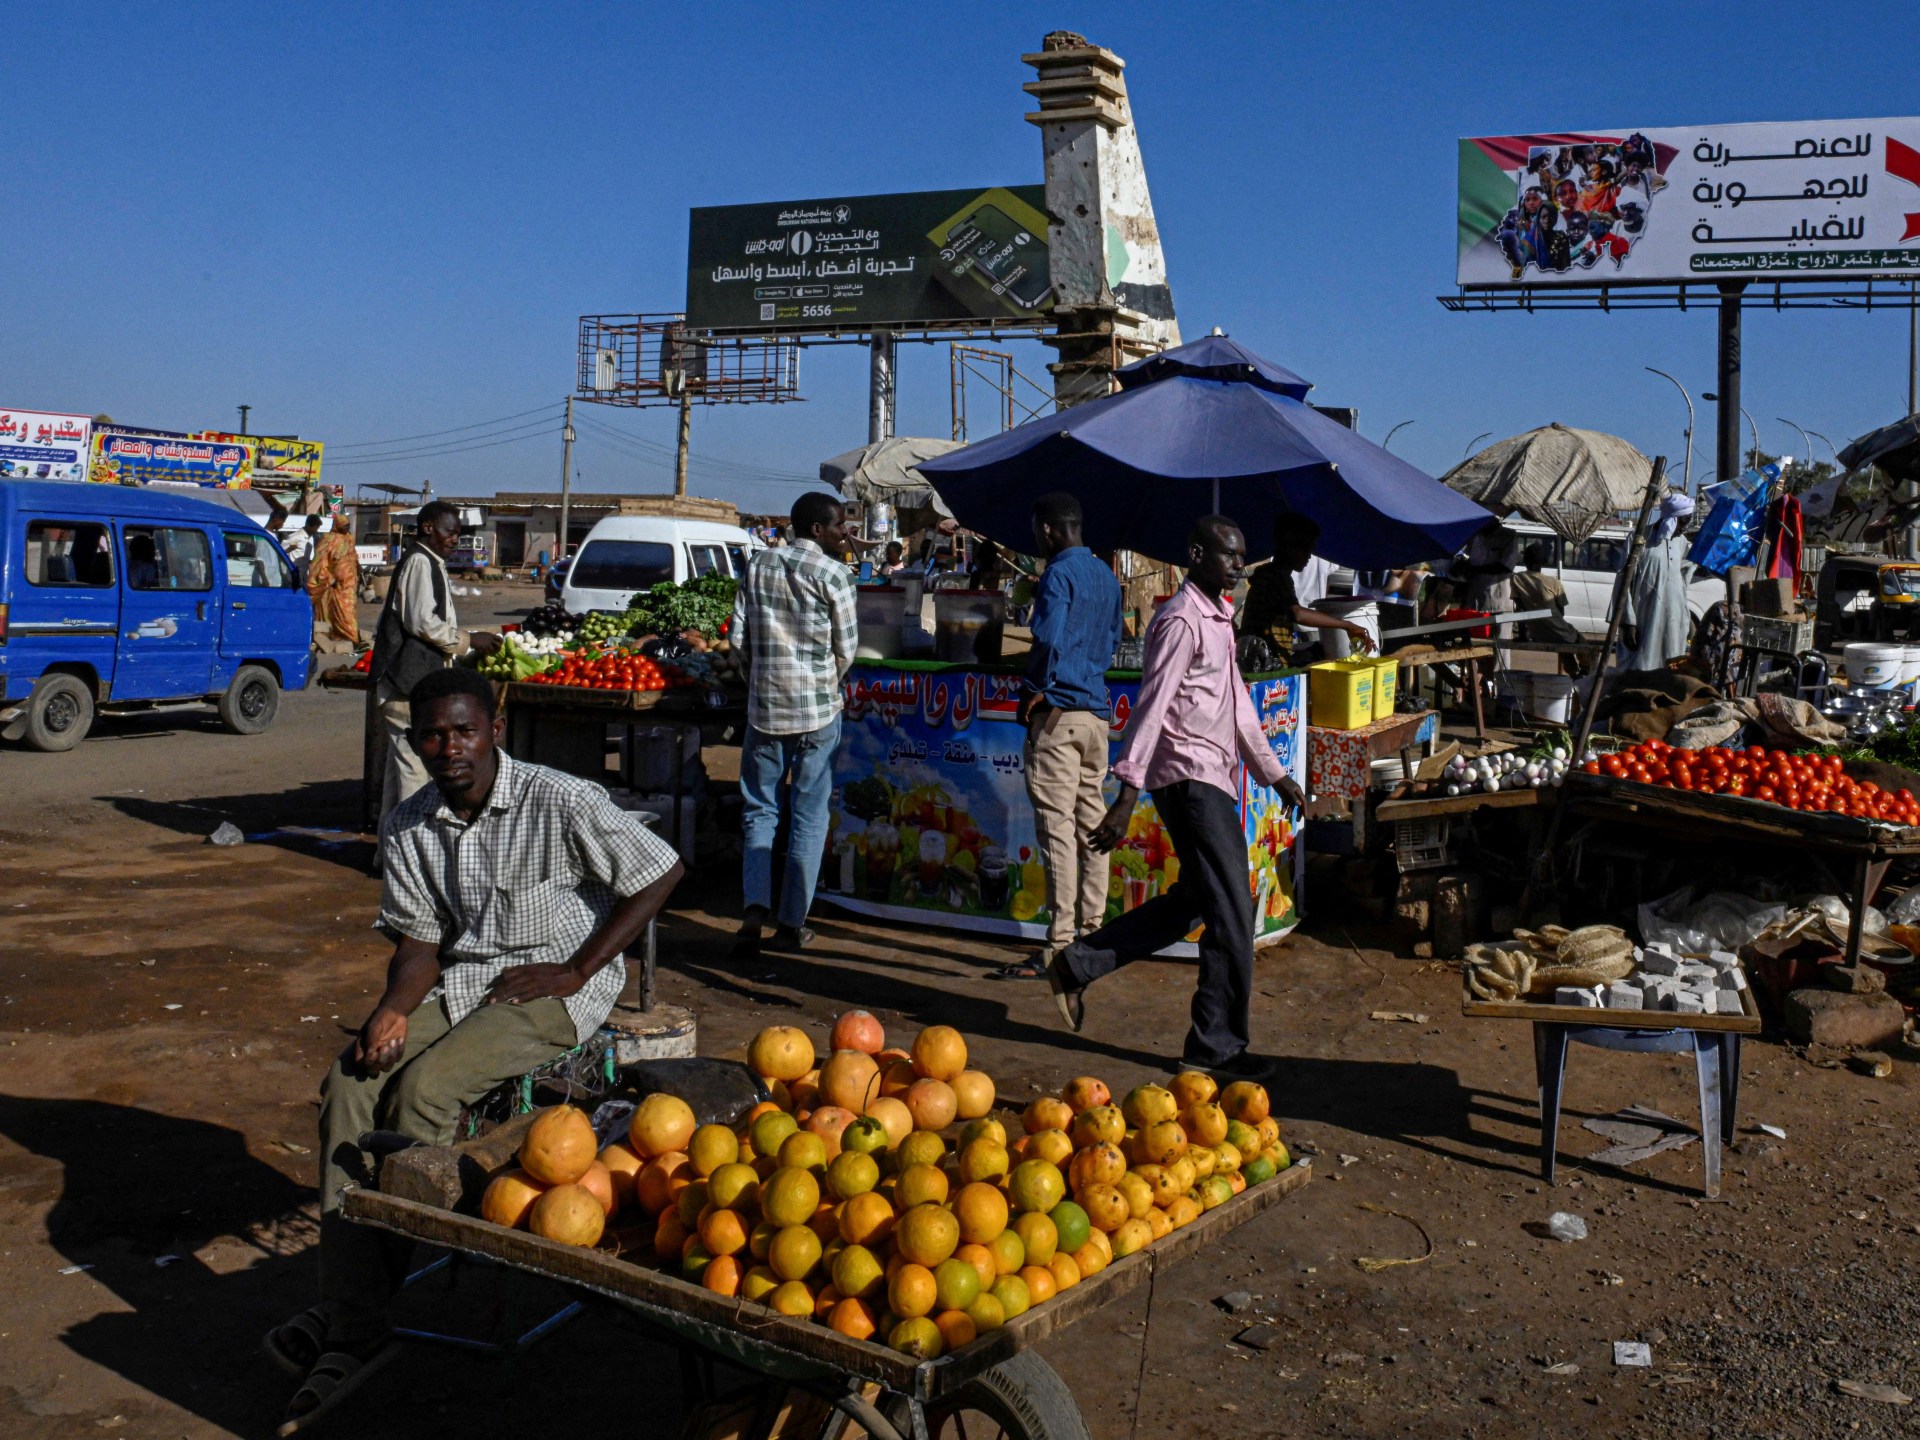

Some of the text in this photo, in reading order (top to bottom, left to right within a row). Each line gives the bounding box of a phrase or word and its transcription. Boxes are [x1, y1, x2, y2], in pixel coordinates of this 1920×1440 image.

[1693, 132, 1872, 168] للعنصرية
[1692, 173, 1868, 210] للجهوية
[865, 229, 880, 241] مع
[1691, 213, 1865, 247] للقبلية
[712, 262, 762, 283] وأسهل
[815, 257, 861, 278] أفضل
[865, 256, 916, 277] تجربة
[1691, 255, 1755, 270] المجتمعات
[802, 305, 832, 317] 5656
[943, 743, 976, 766] منقة
